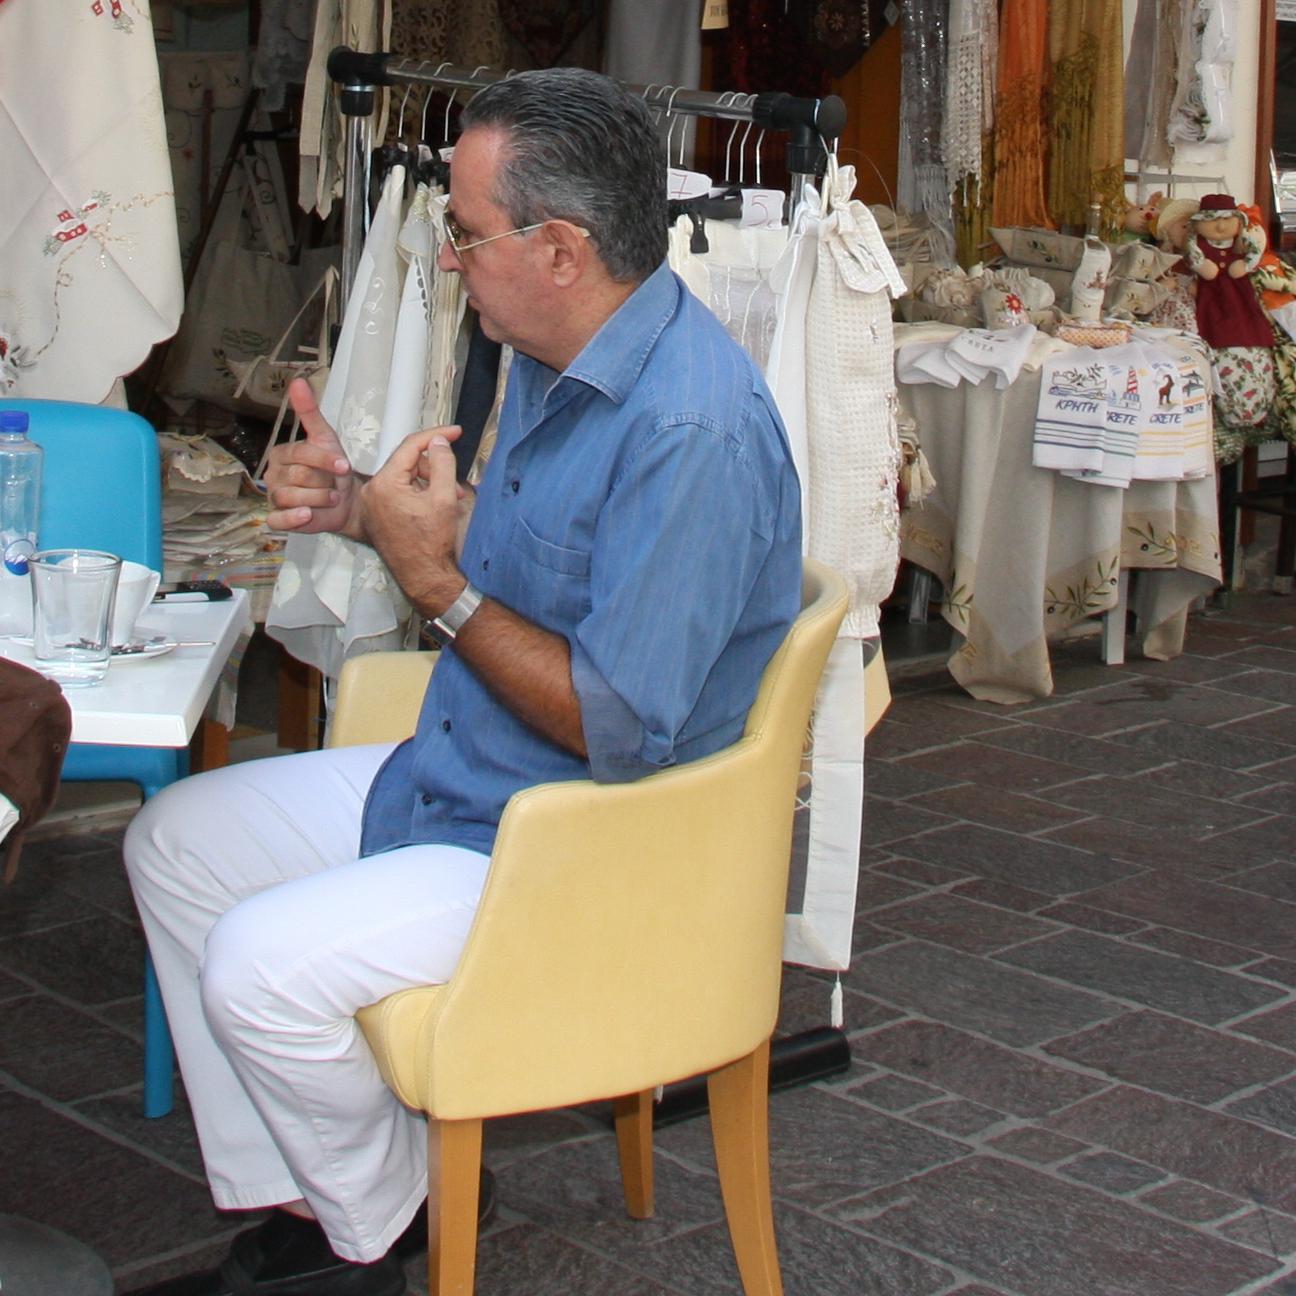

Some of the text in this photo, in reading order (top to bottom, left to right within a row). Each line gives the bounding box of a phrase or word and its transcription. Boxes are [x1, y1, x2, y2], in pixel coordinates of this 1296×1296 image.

[670, 172, 693, 199] 7
[1055, 398, 1099, 414] ΚΡΗΤΗ
[1106, 410, 1138, 426] RETE
[1149, 412, 1182, 425] CRETE
